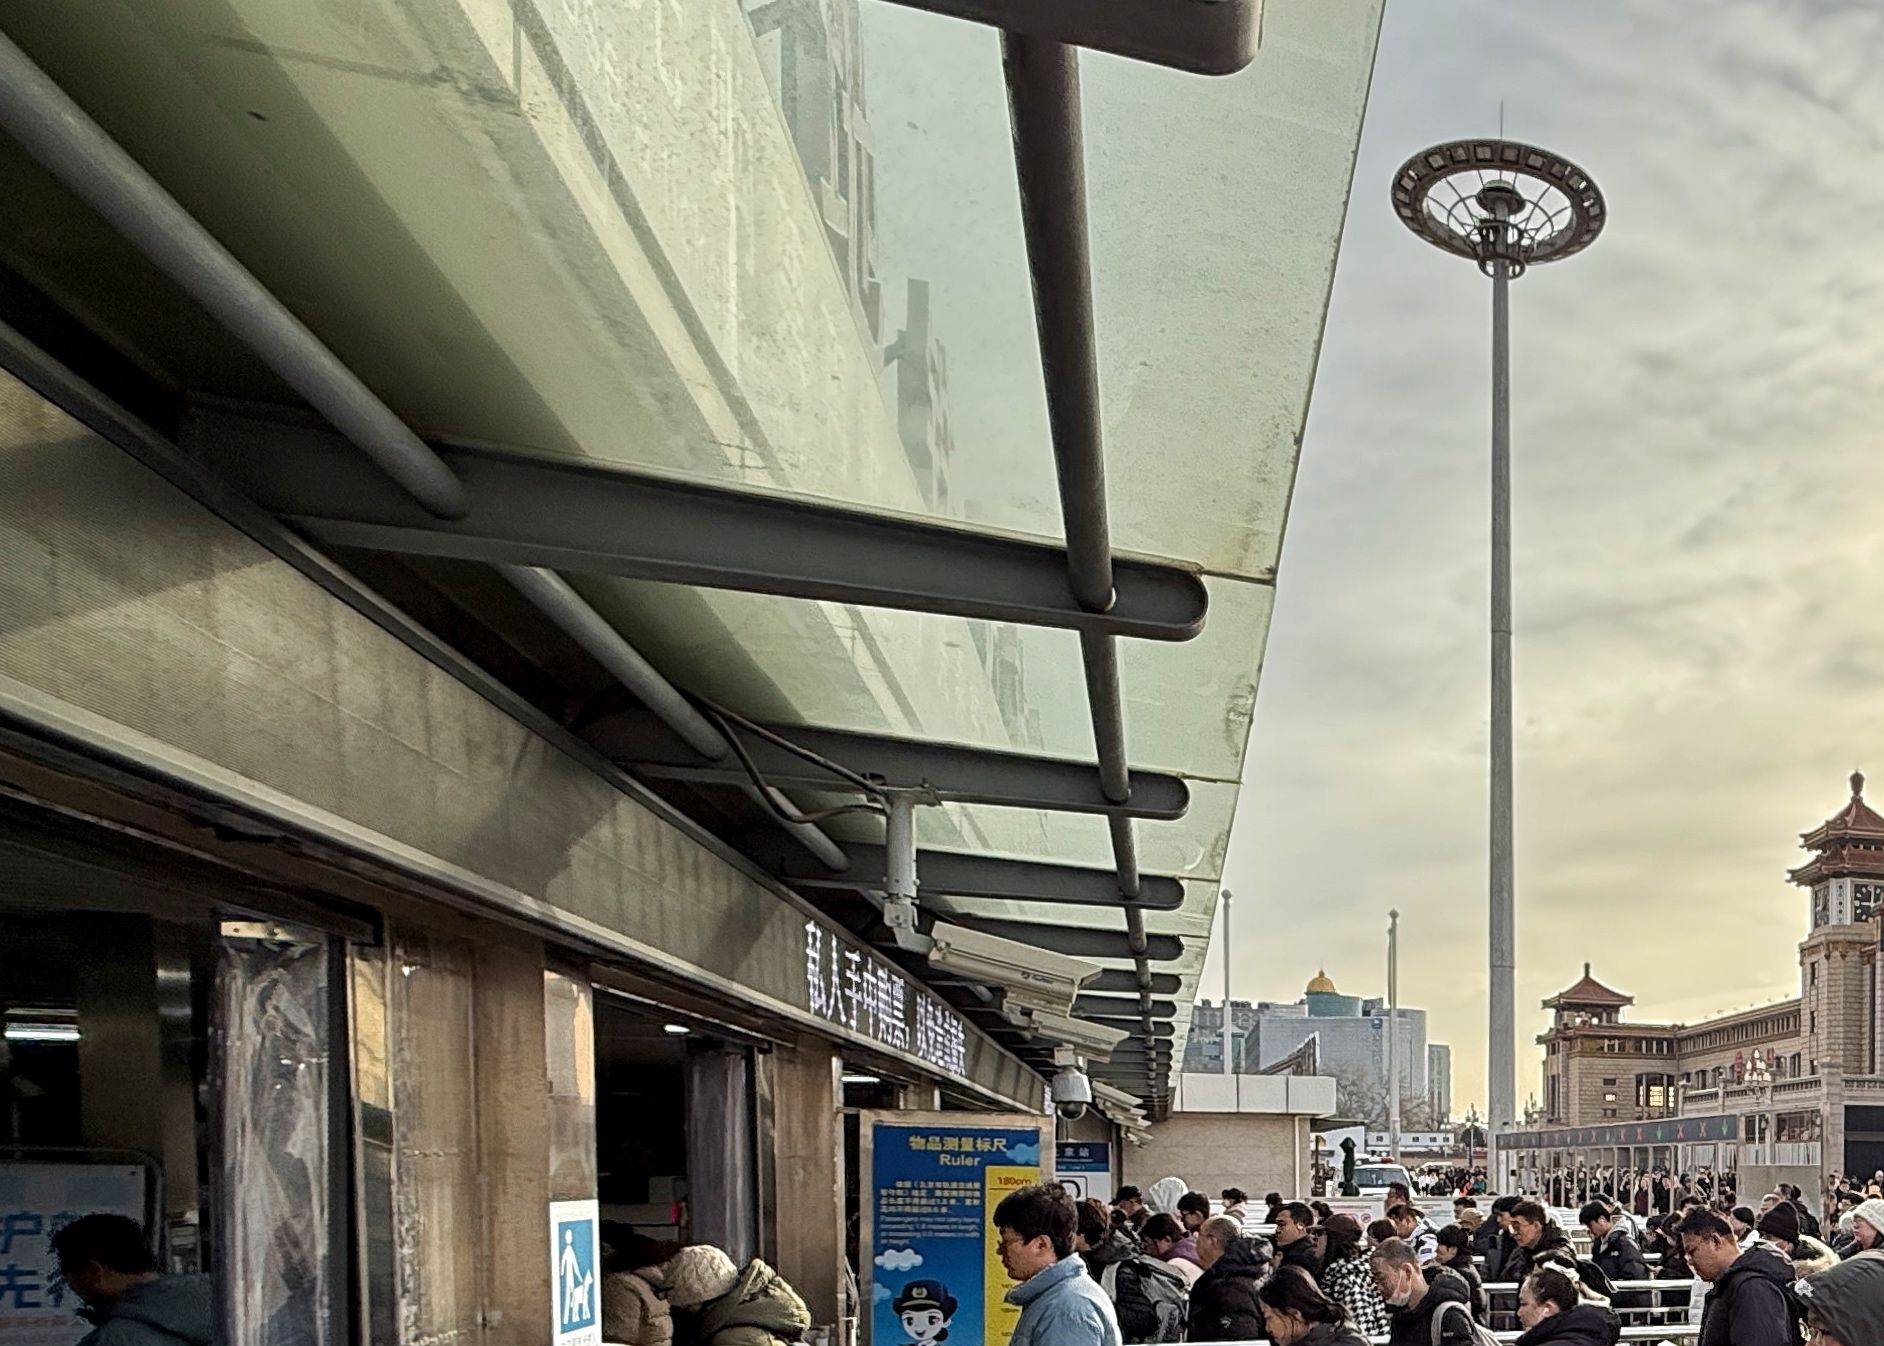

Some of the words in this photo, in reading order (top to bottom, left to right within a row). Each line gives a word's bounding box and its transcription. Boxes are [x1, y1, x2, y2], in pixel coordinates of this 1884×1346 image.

[908, 1135, 1008, 1152] 物品测量标尺
[939, 1153, 981, 1166] Ruler
[997, 1176, 1032, 1186] 180cm
